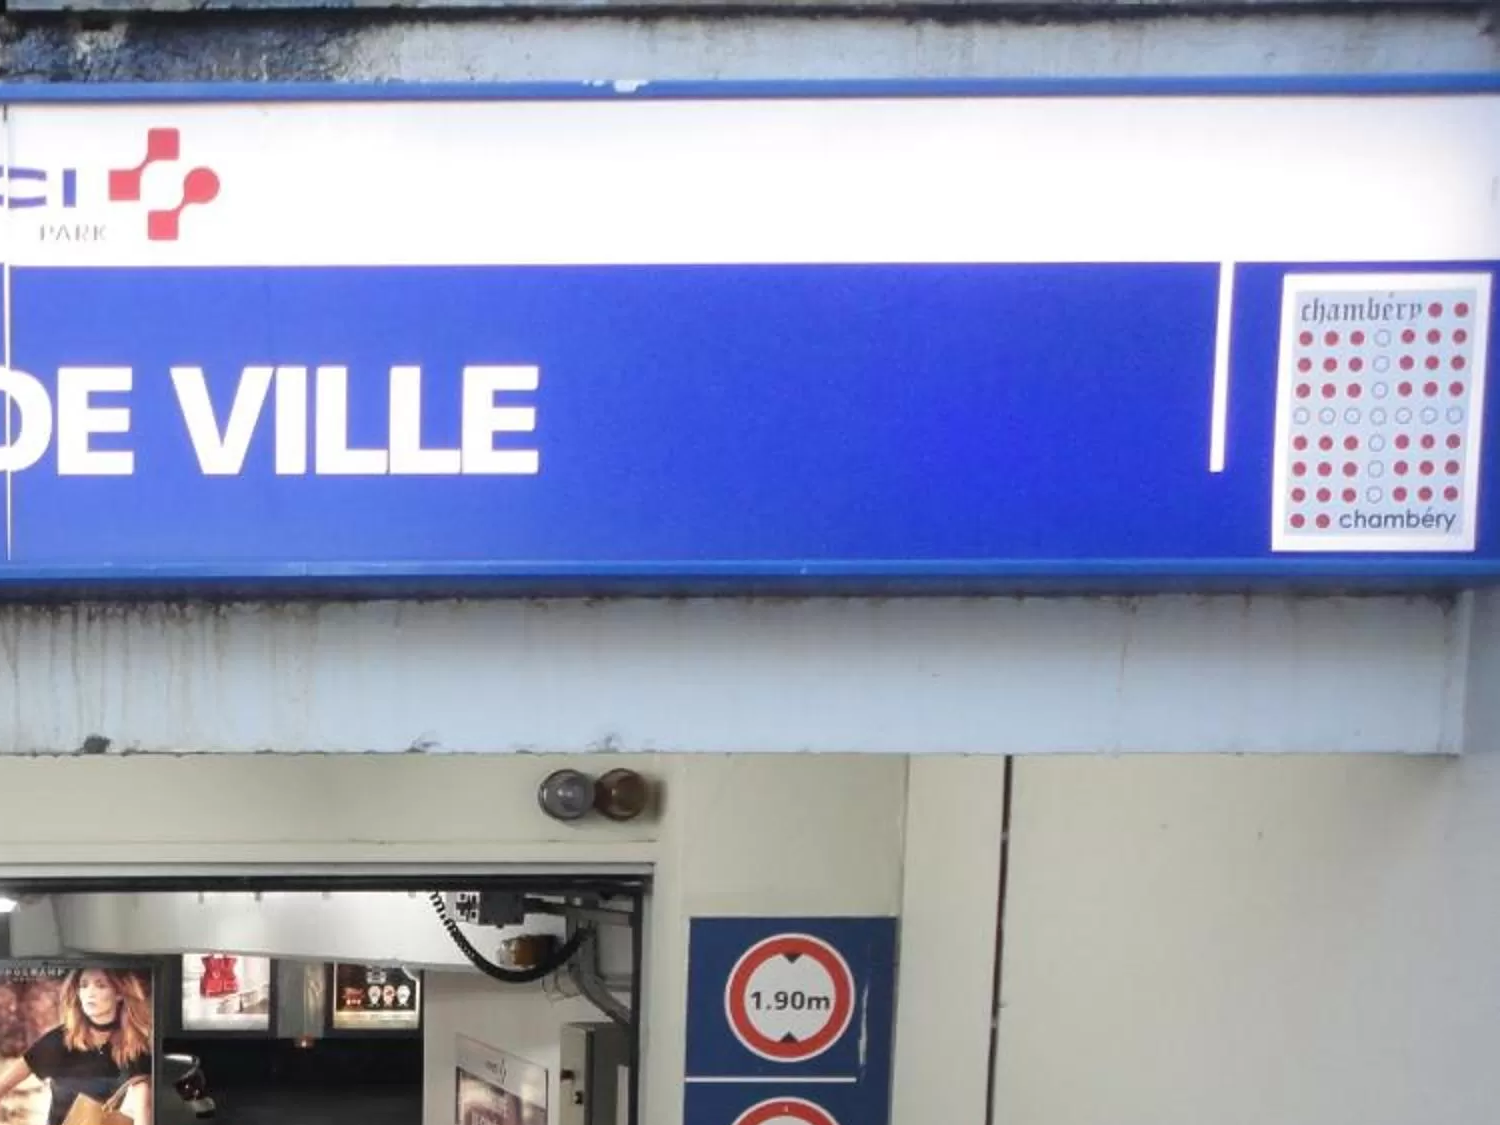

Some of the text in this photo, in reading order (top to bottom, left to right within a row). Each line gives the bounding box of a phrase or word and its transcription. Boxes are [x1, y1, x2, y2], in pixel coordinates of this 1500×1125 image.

[38, 223, 106, 242] PARK
[170, 365, 539, 475] VILLE
[1339, 507, 1456, 532] chambéry
[751, 990, 831, 1011] 1.90m
